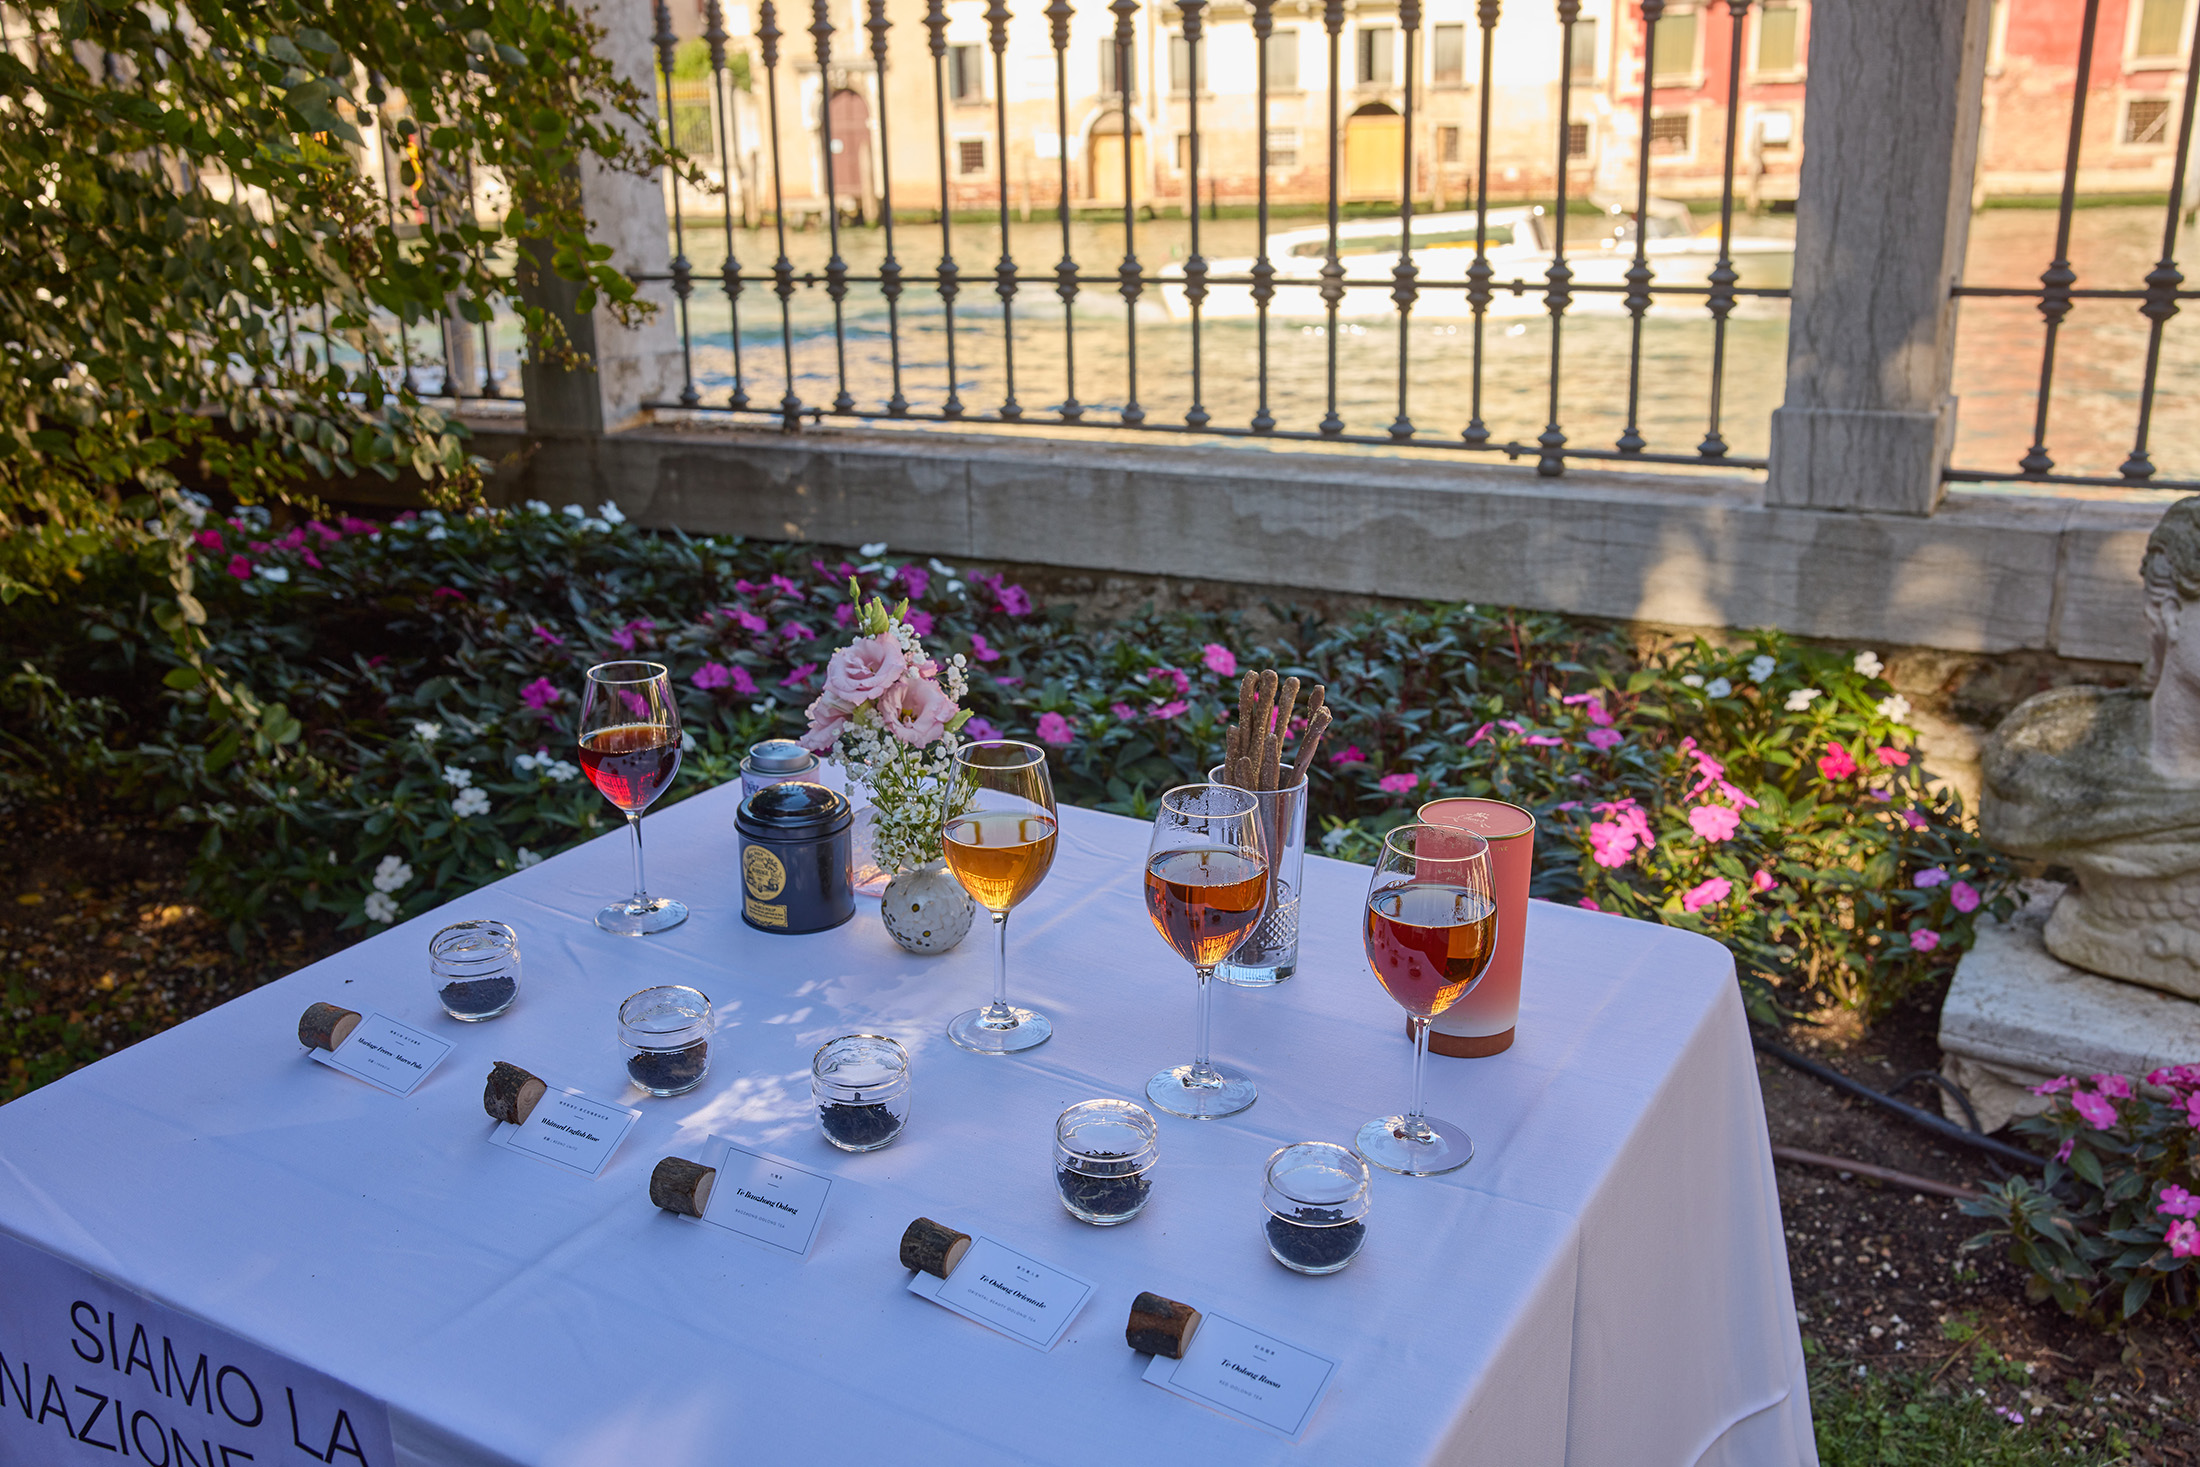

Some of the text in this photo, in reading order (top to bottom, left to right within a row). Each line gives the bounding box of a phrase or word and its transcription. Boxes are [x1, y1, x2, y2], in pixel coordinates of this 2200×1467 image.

[775, 1201, 799, 1216] Oolong
[988, 1279, 1013, 1296] Oolong
[1012, 1290, 1047, 1309] Orientale
[70, 1300, 370, 1467] SIAMO LA
[1231, 1363, 1259, 1380] Oolong
[1258, 1374, 1281, 1389] Rosso
